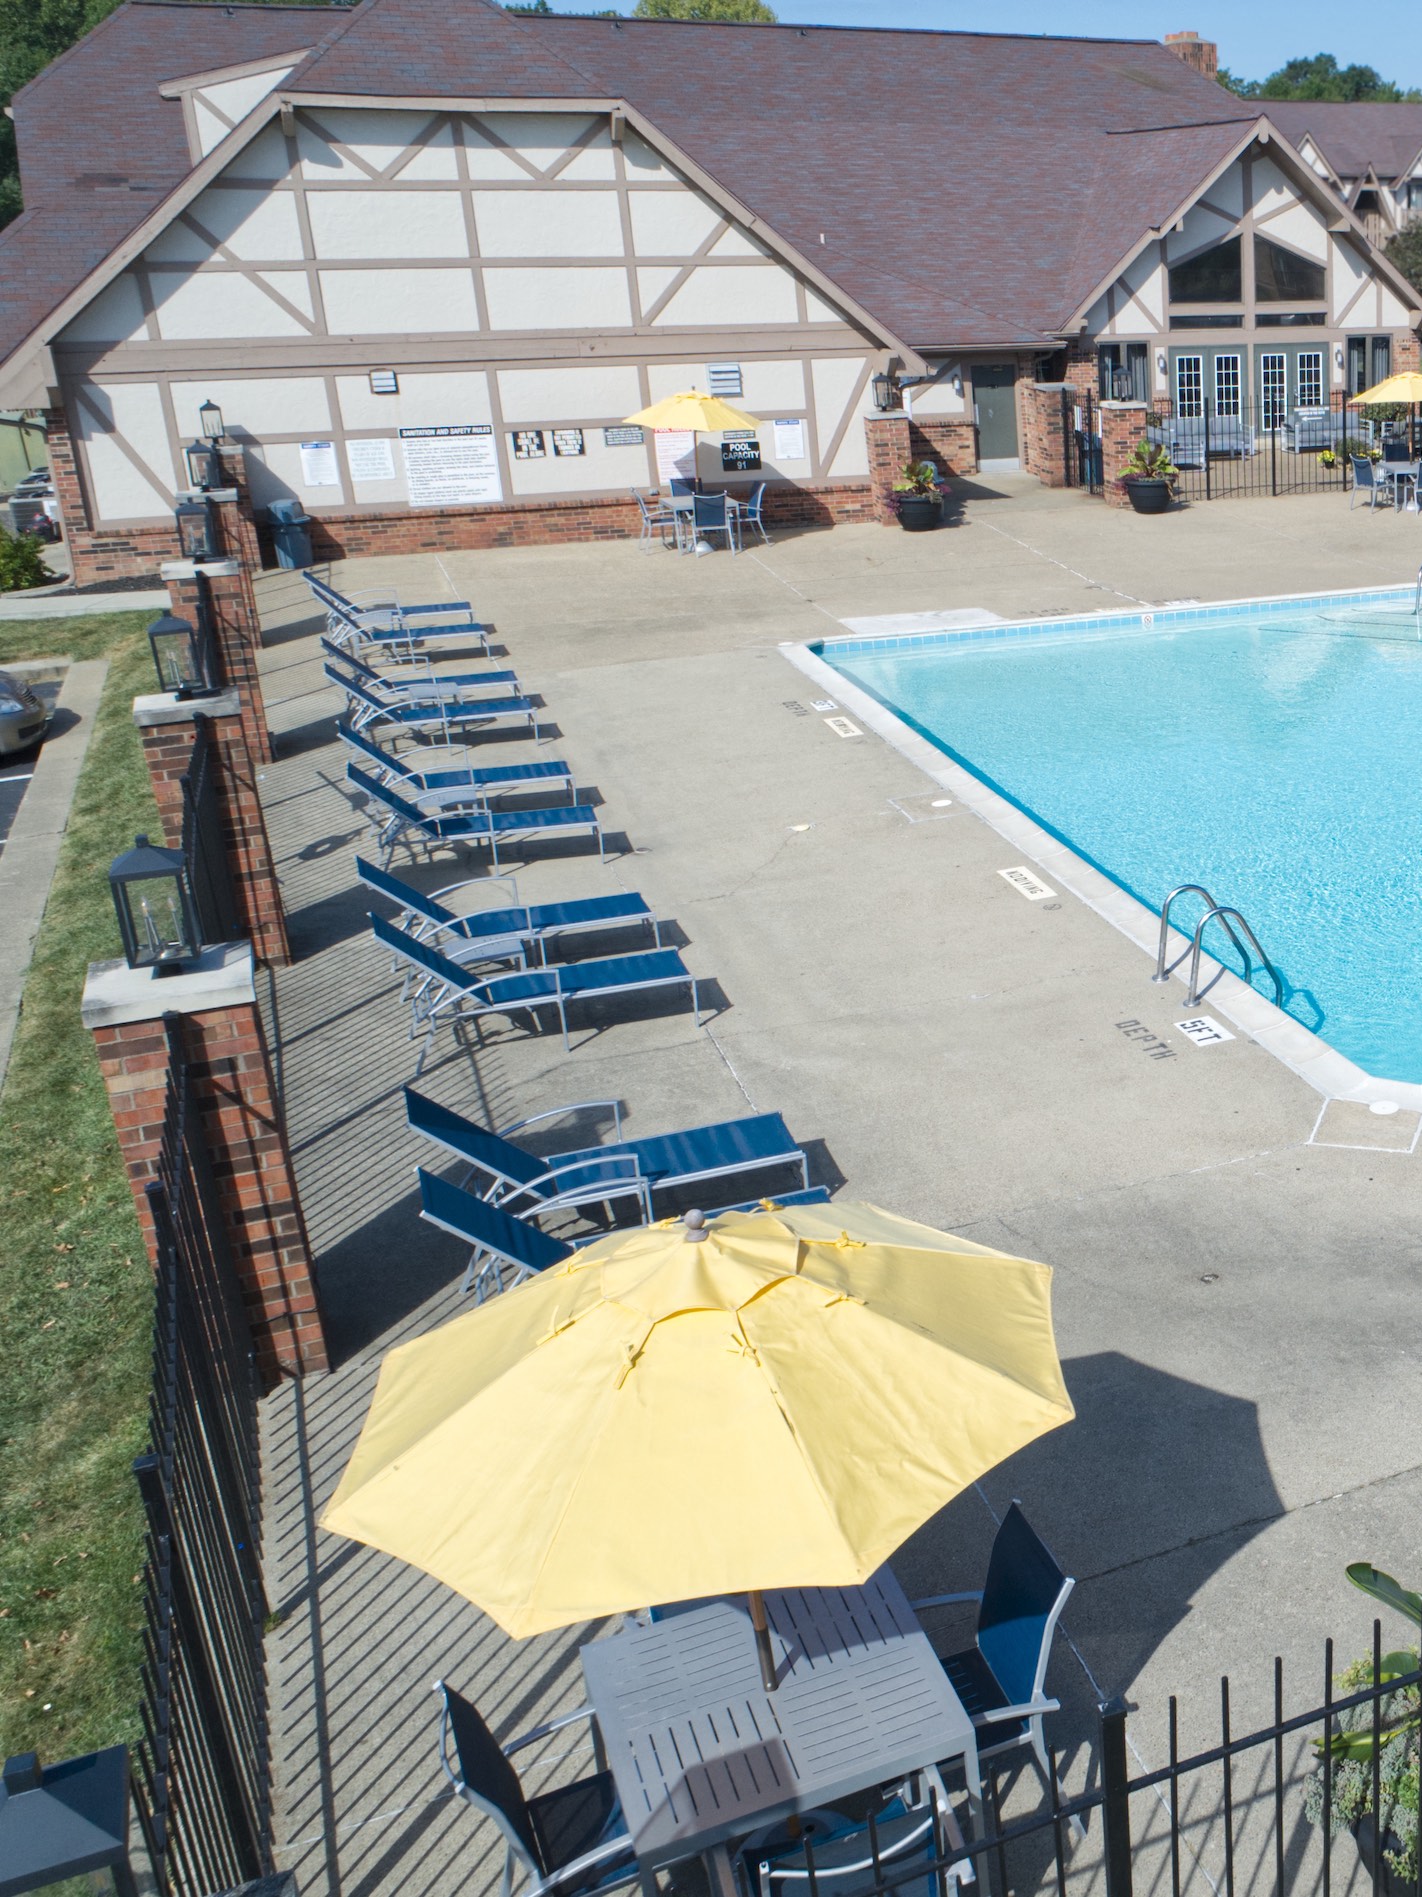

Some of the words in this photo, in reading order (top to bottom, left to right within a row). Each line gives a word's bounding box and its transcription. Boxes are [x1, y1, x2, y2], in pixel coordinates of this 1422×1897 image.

[402, 428, 436, 437] SANITATION
[436, 428, 449, 436] AND
[450, 427, 471, 435] SAFETY
[472, 426, 491, 434] RULES
[729, 443, 751, 451] POOL
[723, 451, 760, 460] CAPACITY
[737, 461, 747, 470] 91
[1180, 1019, 1222, 1042] 5FT
[1114, 1019, 1177, 1061] DEPTH
